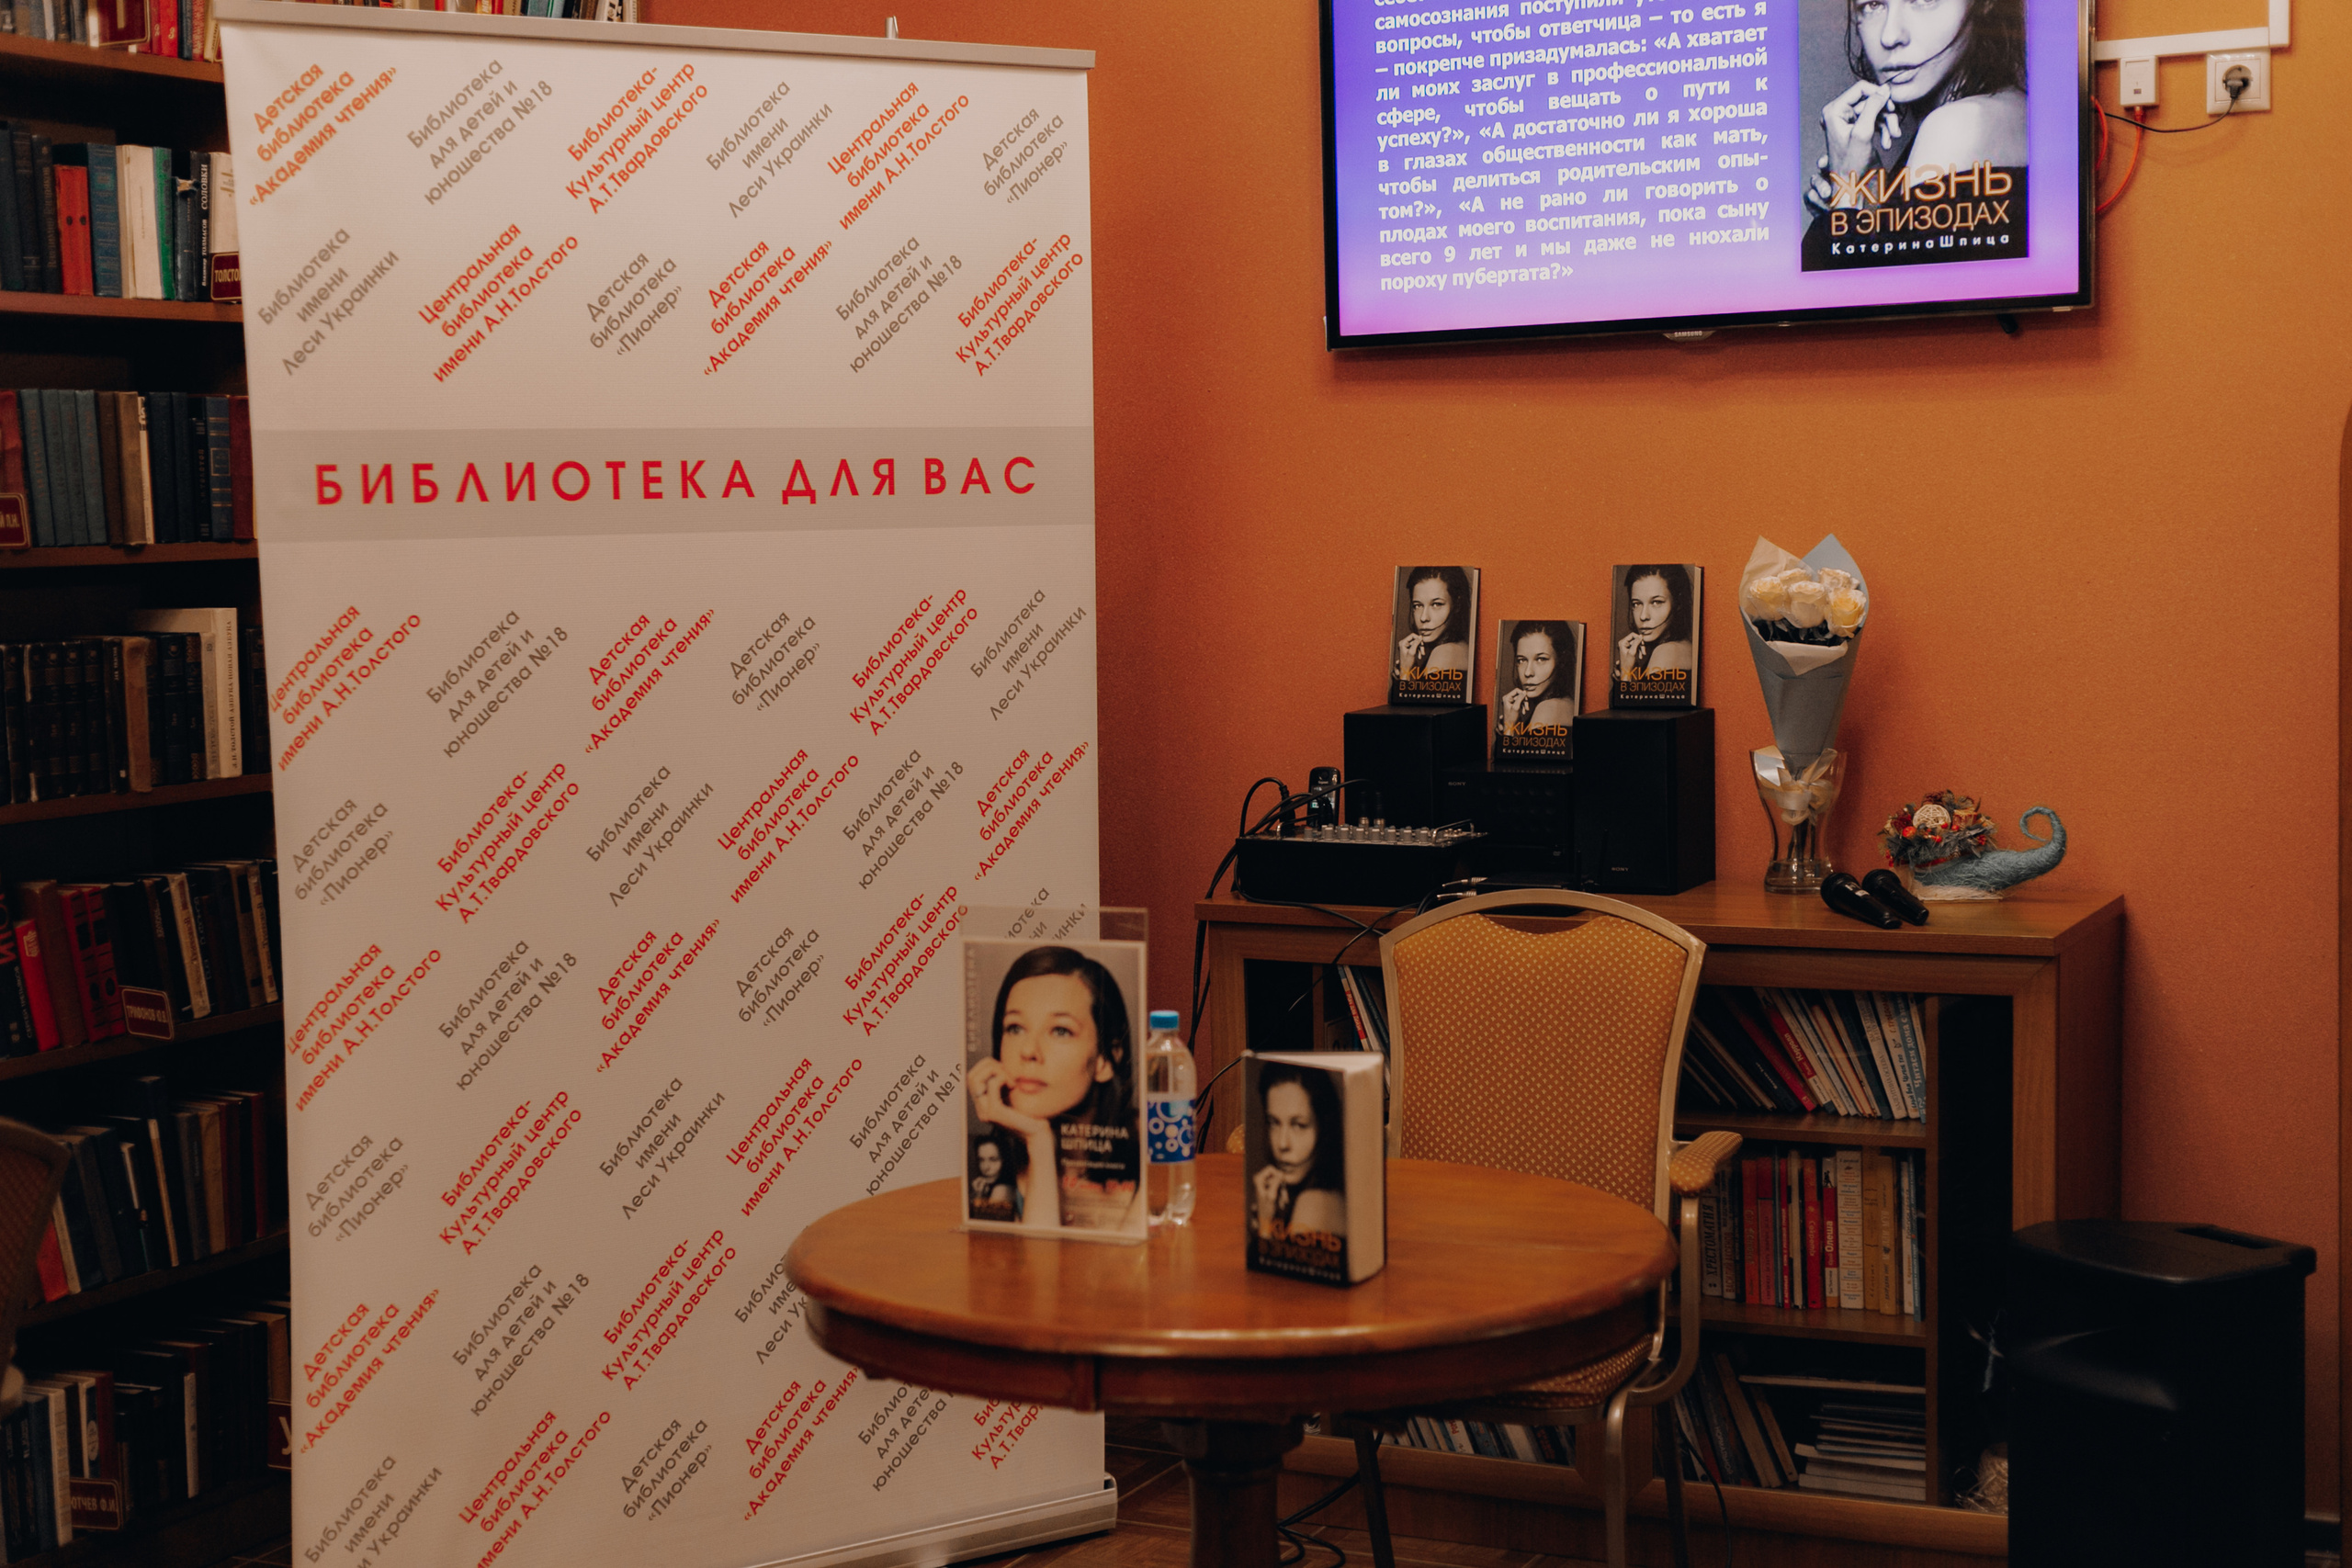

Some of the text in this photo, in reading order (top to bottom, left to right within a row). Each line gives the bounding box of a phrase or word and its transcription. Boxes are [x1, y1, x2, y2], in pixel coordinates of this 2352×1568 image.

[1374, 3, 1510, 31] самосознания
[1376, 1, 1767, 55] вопросы, чтобы ответчица то есть я
[1376, 46, 1768, 102] ли моих заслуг в профессиональной
[1393, 26, 1768, 77] покрепче призадумалась: «А хватает
[254, 63, 324, 134] Детская
[256, 71, 355, 162] библиотека
[407, 61, 503, 149] Библиотека
[430, 80, 518, 169] для детей и
[1377, 76, 1769, 129] сфере, чтобы вещать о пути к
[1377, 101, 1768, 153] успеху?», «А достаточно ли я хороша
[249, 67, 396, 206] «Академия чтения»
[424, 80, 552, 205] юношества №18
[1378, 128, 1769, 173] в глазах общественности как мать,
[200, 164, 209, 211] СОЛОВКИ
[1379, 152, 1769, 196] чтобы делиться родительским опы-
[1379, 176, 1769, 220] том?», «А не рано ли говорить о
[1829, 160, 2013, 208] ЖИЗНЬ
[1380, 201, 1770, 243] плодах моего воспитания, пока сыну
[1381, 226, 1770, 267] всего 9 лет и мы даже не нюхали
[1831, 199, 2010, 236] В ЭПИЗОДАХ
[214, 267, 242, 284] ТОЛСТО
[418, 223, 522, 324] Центральная
[441, 245, 535, 337] библиотека
[955, 233, 1071, 364] Культурный центр
[956, 238, 1037, 329] Библиотека-
[1381, 263, 1574, 293] пороху пубертата?»
[433, 236, 579, 383] имени А.Н.Толстого
[975, 253, 1083, 378] А.Т.Твардовского
[1673, 330, 1703, 339] SAMSUNG
[315, 457, 1036, 505] БИБЛИОТЕКА ДЛЯ ВАС
[969, 589, 1046, 679] Библиотека
[989, 606, 1087, 721] Леси Украинки
[1001, 623, 1044, 674] имени
[1399, 681, 1462, 693] В ЭПИЗОДАХ
[1400, 666, 1463, 681] ЖИЗНЬ
[1621, 666, 1687, 681] ЖИЗНЬ
[1621, 682, 1685, 693] В ЭПИЗОДАХ
[1503, 722, 1568, 737] ЖИЗНЬ
[1503, 737, 1566, 748] В ЭПИЗОДАХ
[717, 749, 809, 851] Центральная
[729, 754, 859, 904] имени А.Н.Толстого
[737, 768, 820, 861] библиотека
[292, 799, 358, 874] Детская
[295, 802, 389, 900] библиотека
[321, 830, 393, 906] «Пионер»
[440, 1100, 531, 1208] Библиотека-
[1061, 1122, 1130, 1140] КАТЕРИНА
[438, 1090, 569, 1246] Культурный центр
[461, 1109, 582, 1257] А.Т.Твардовского
[1702, 1203, 1718, 1277] ХРЕСТОМАТИЯ
[1825, 1220, 1836, 1253] Олеша
[620, 1418, 683, 1495] Детская
[623, 1419, 708, 1518] библиотека
[648, 1444, 712, 1521] «Пионер»
